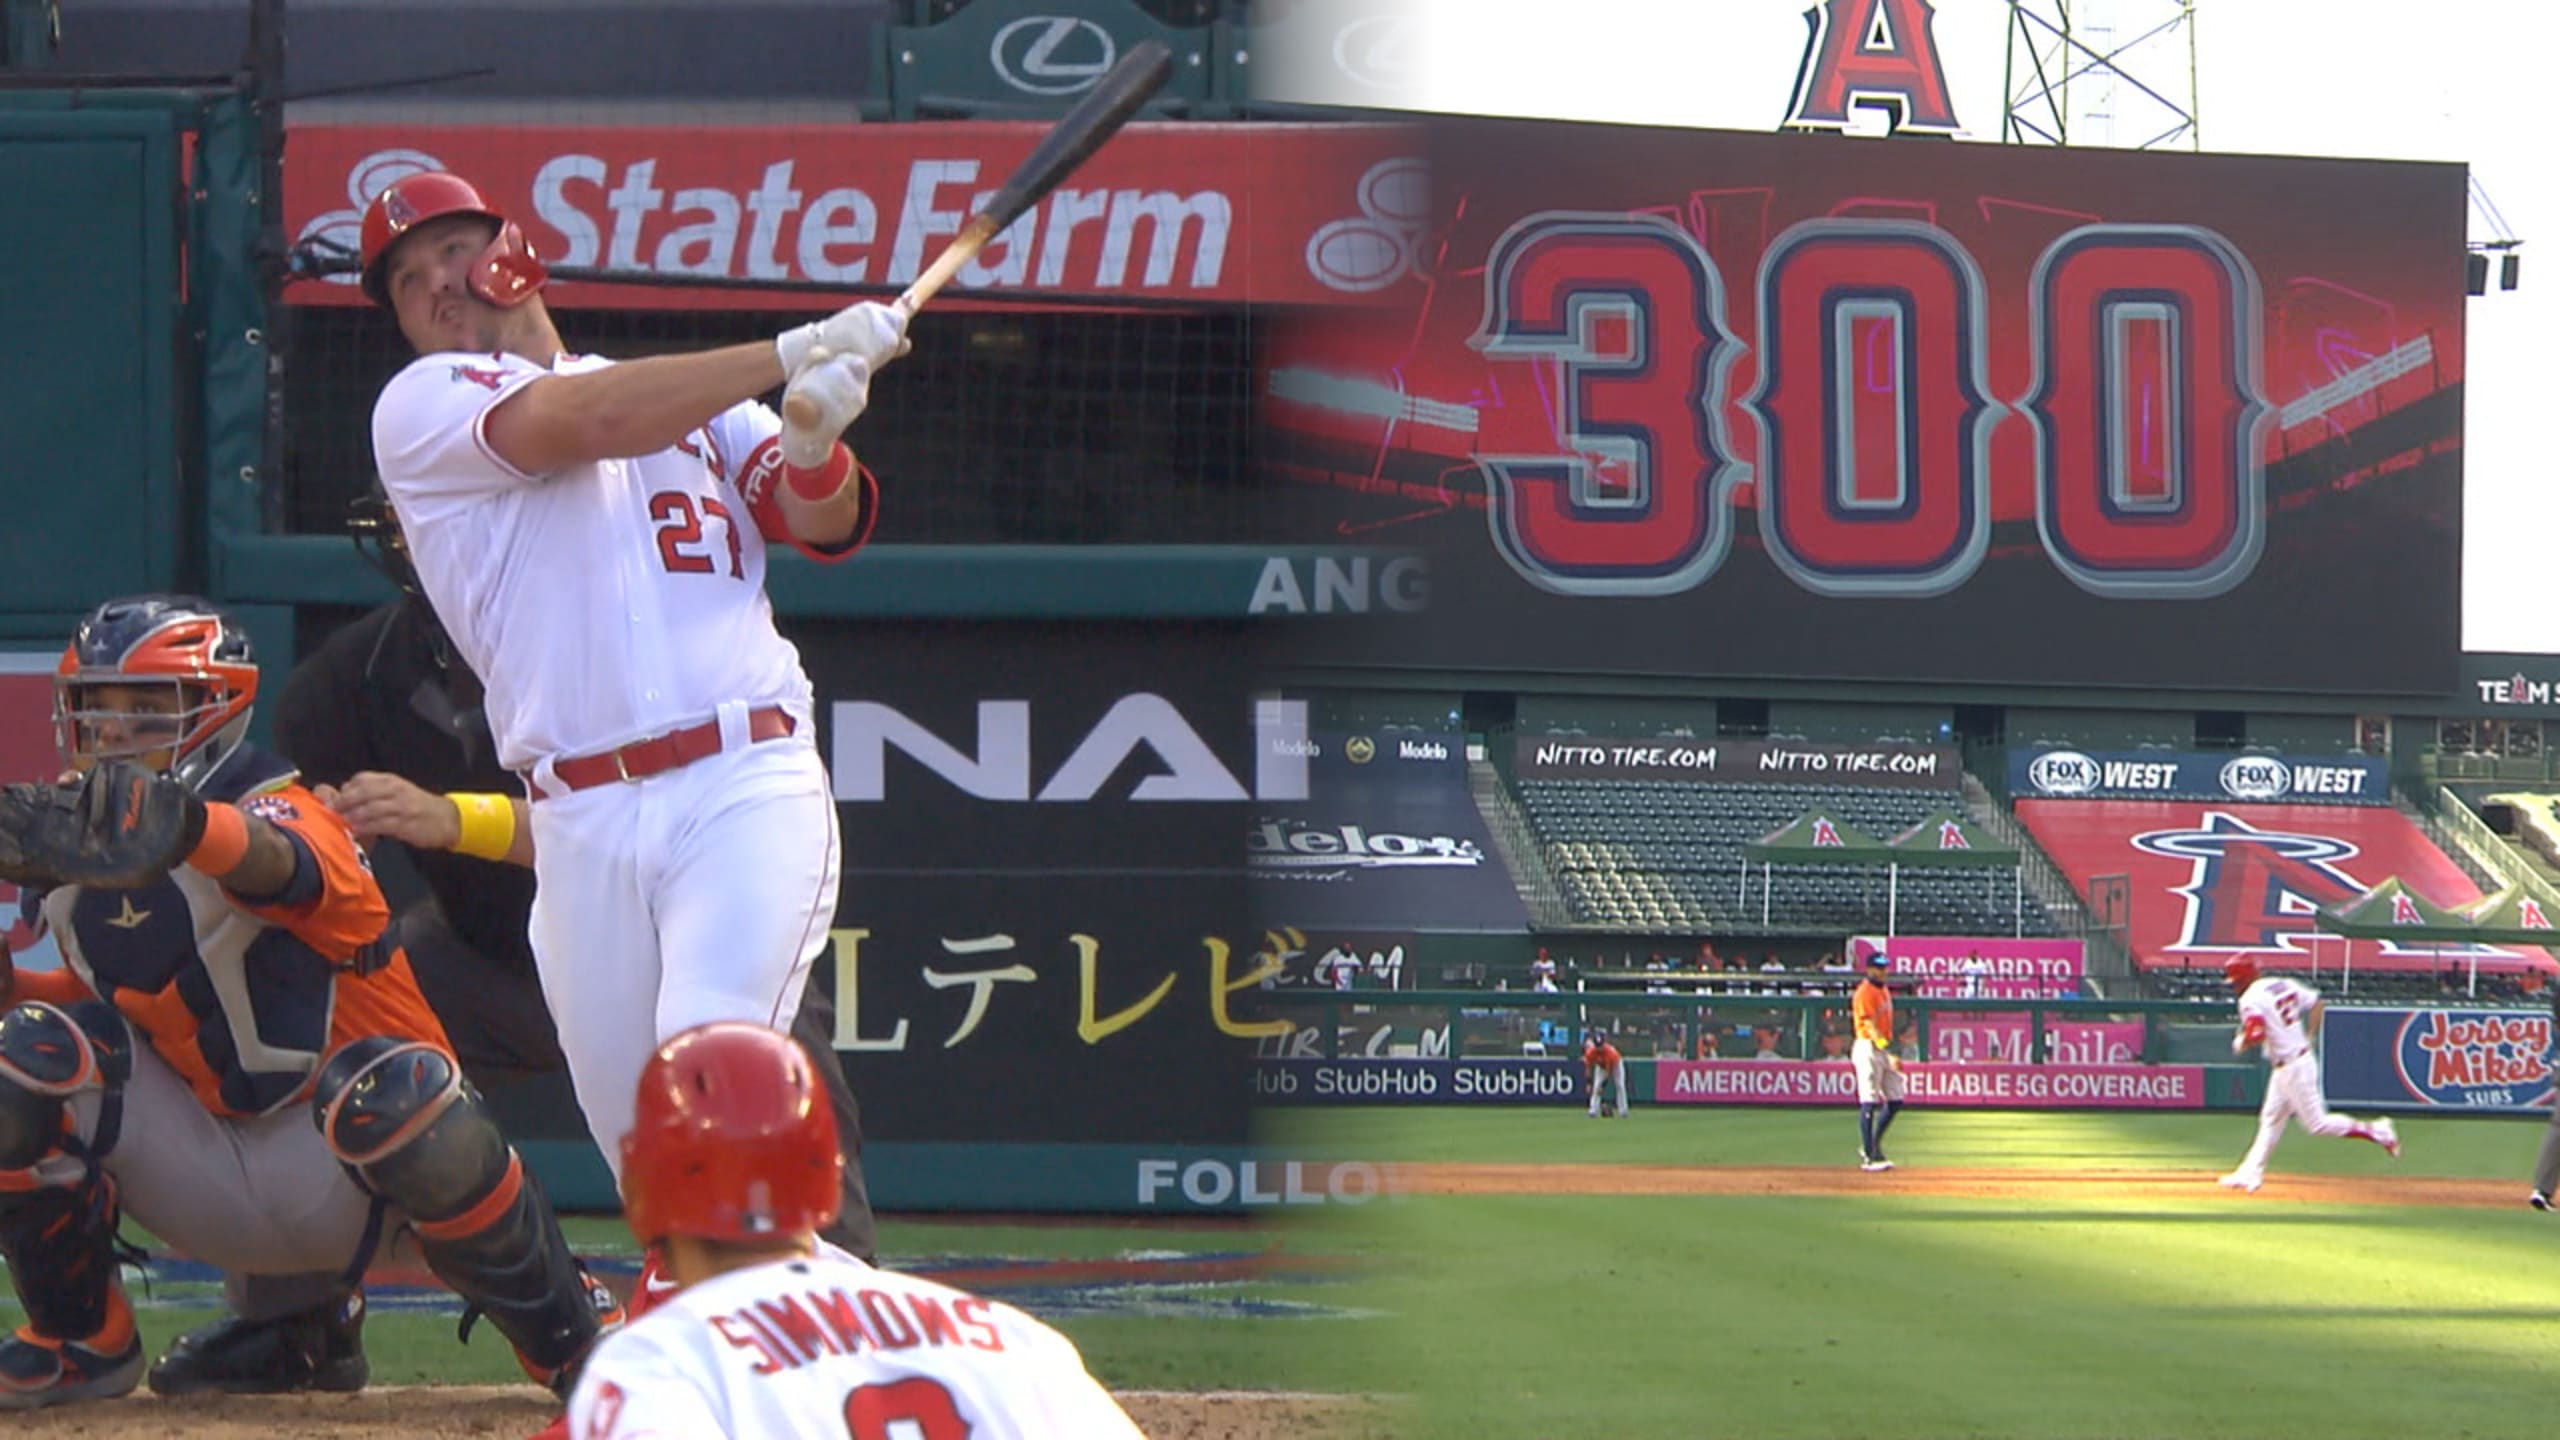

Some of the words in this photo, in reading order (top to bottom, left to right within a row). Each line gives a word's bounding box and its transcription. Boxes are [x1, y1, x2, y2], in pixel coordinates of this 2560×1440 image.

[1466, 212, 2281, 598] 300
[649, 490, 744, 580] 27
[2477, 672, 2550, 704] TEAM
[1400, 741, 1447, 760] Modelo
[1536, 743, 1605, 767] NITTO
[1611, 746, 1716, 770] TIRE.COM
[1760, 748, 1828, 773] NITTO
[1835, 751, 1936, 776] TIRE.COM
[2047, 760, 2084, 778] FOX
[2104, 762, 2178, 789] WEST
[2237, 765, 2275, 784] FOX
[2294, 767, 2366, 793] WEST
[1896, 957, 2036, 984] BACKARD
[2420, 1013, 2549, 1051] Jersey
[1315, 1067, 1437, 1094] StubHub
[1454, 1067, 1574, 1094] StubHub
[2430, 1049, 2547, 1088] Mike's
[1673, 1069, 1812, 1095] AMERICA'S
[1817, 1070, 1856, 1095] MO
[2016, 1075, 2048, 1098] 5G
[2053, 1075, 2185, 1099] COVERAGE
[2464, 1089, 2513, 1105] SUBS
[708, 1289, 1005, 1375] SIMMONS
